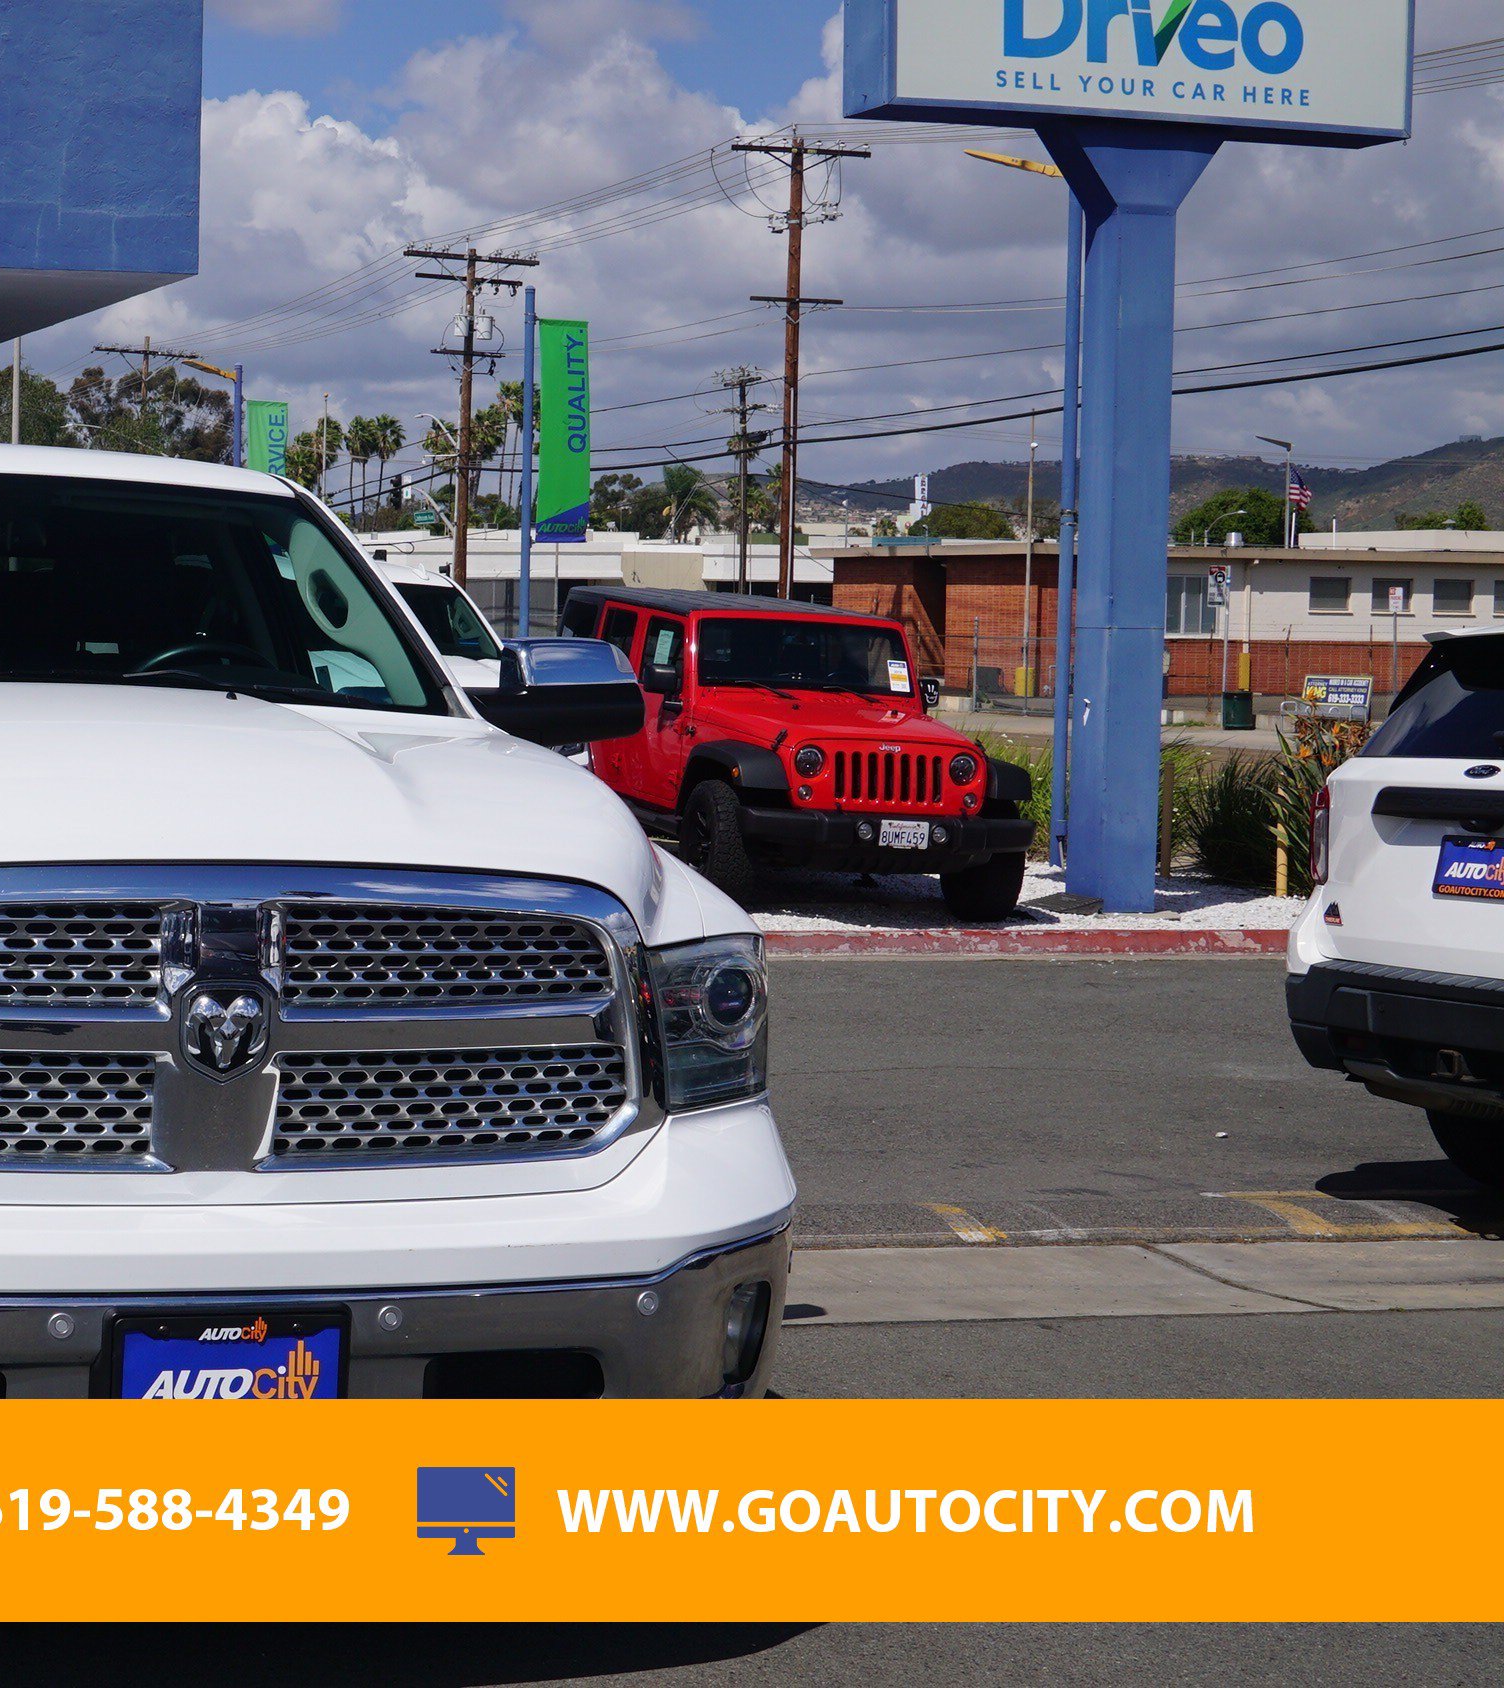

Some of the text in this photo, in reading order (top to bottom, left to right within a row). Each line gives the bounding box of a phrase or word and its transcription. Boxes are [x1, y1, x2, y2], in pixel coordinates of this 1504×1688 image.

[1004, 0, 1304, 75] Driveo
[996, 70, 1310, 106] SELL YOUR CAR HERE
[567, 329, 587, 453] QUALITY.
[268, 409, 285, 476] RVICE.
[879, 743, 901, 753] Jeep
[881, 831, 926, 845] 8UMF459
[198, 1316, 268, 1343] AUTOCity
